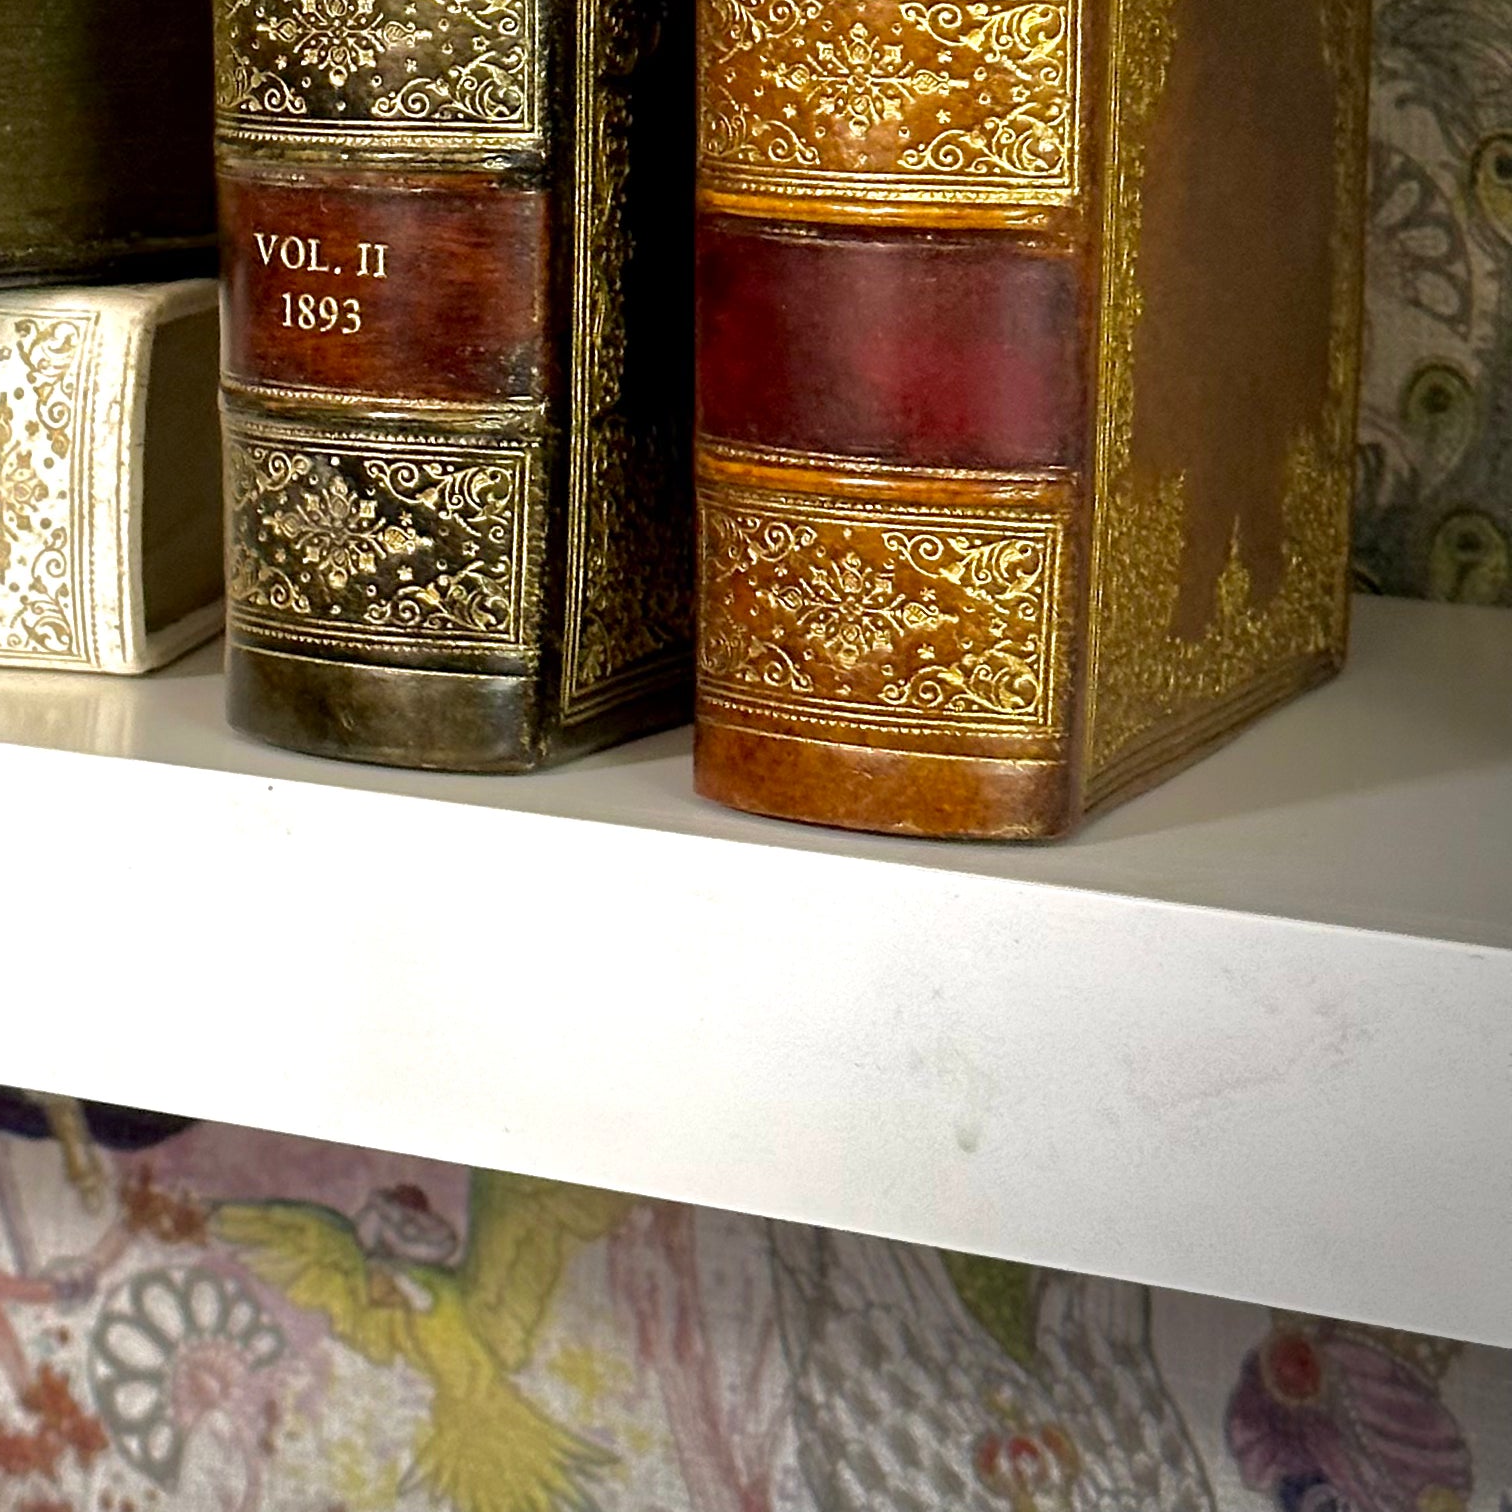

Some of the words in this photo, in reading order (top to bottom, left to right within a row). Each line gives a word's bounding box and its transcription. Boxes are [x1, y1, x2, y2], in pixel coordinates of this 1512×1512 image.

[253, 233, 342, 275] VOL.
[356, 242, 389, 279] II
[282, 292, 362, 334] 1893
